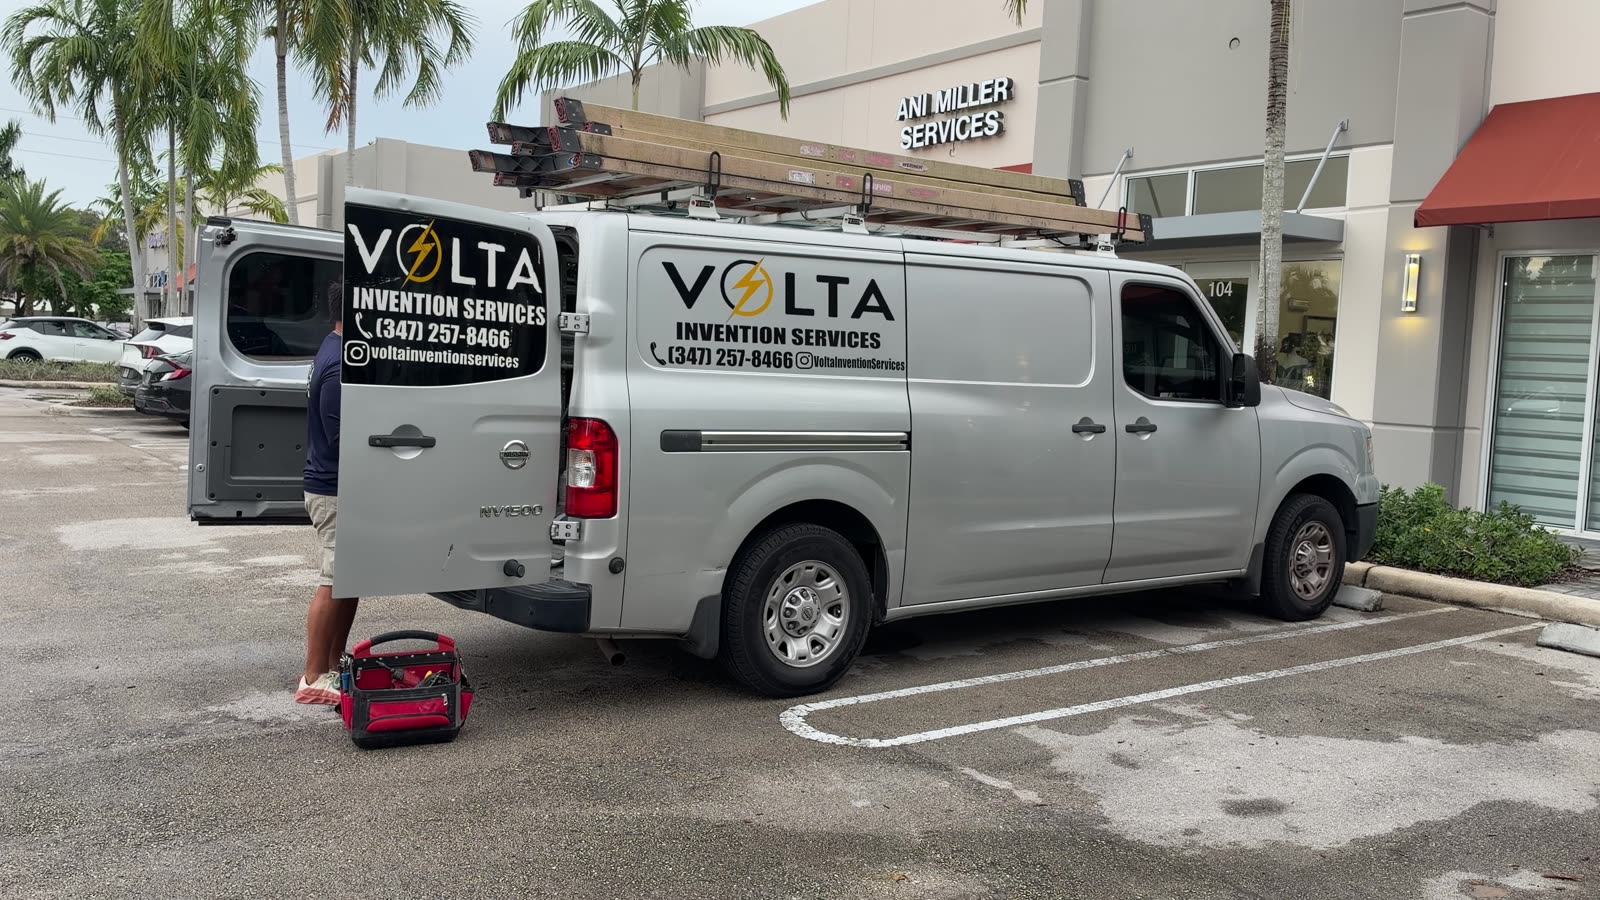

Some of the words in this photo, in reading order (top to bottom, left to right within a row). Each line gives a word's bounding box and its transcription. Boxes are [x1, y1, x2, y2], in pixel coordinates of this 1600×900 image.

[896, 93, 930, 121] ANI
[935, 77, 1011, 114] MILLER
[900, 110, 1001, 150] SERVICES
[347, 220, 543, 293] VOLTA
[661, 258, 895, 321] VOLTA
[1209, 281, 1233, 297] 104
[353, 287, 458, 318] INVENTION
[463, 298, 546, 326] SERVICES
[375, 318, 423, 341] (347)
[428, 322, 510, 349] 257-8466
[676, 321, 787, 345] INVENTION
[791, 328, 881, 350] SERVICES
[371, 345, 519, 369] voltainventionservices
[668, 346, 712, 366] (347)
[716, 348, 793, 369] 257-8466
[814, 355, 906, 372] VoltaInventionServices
[480, 504, 543, 518] NV1500
